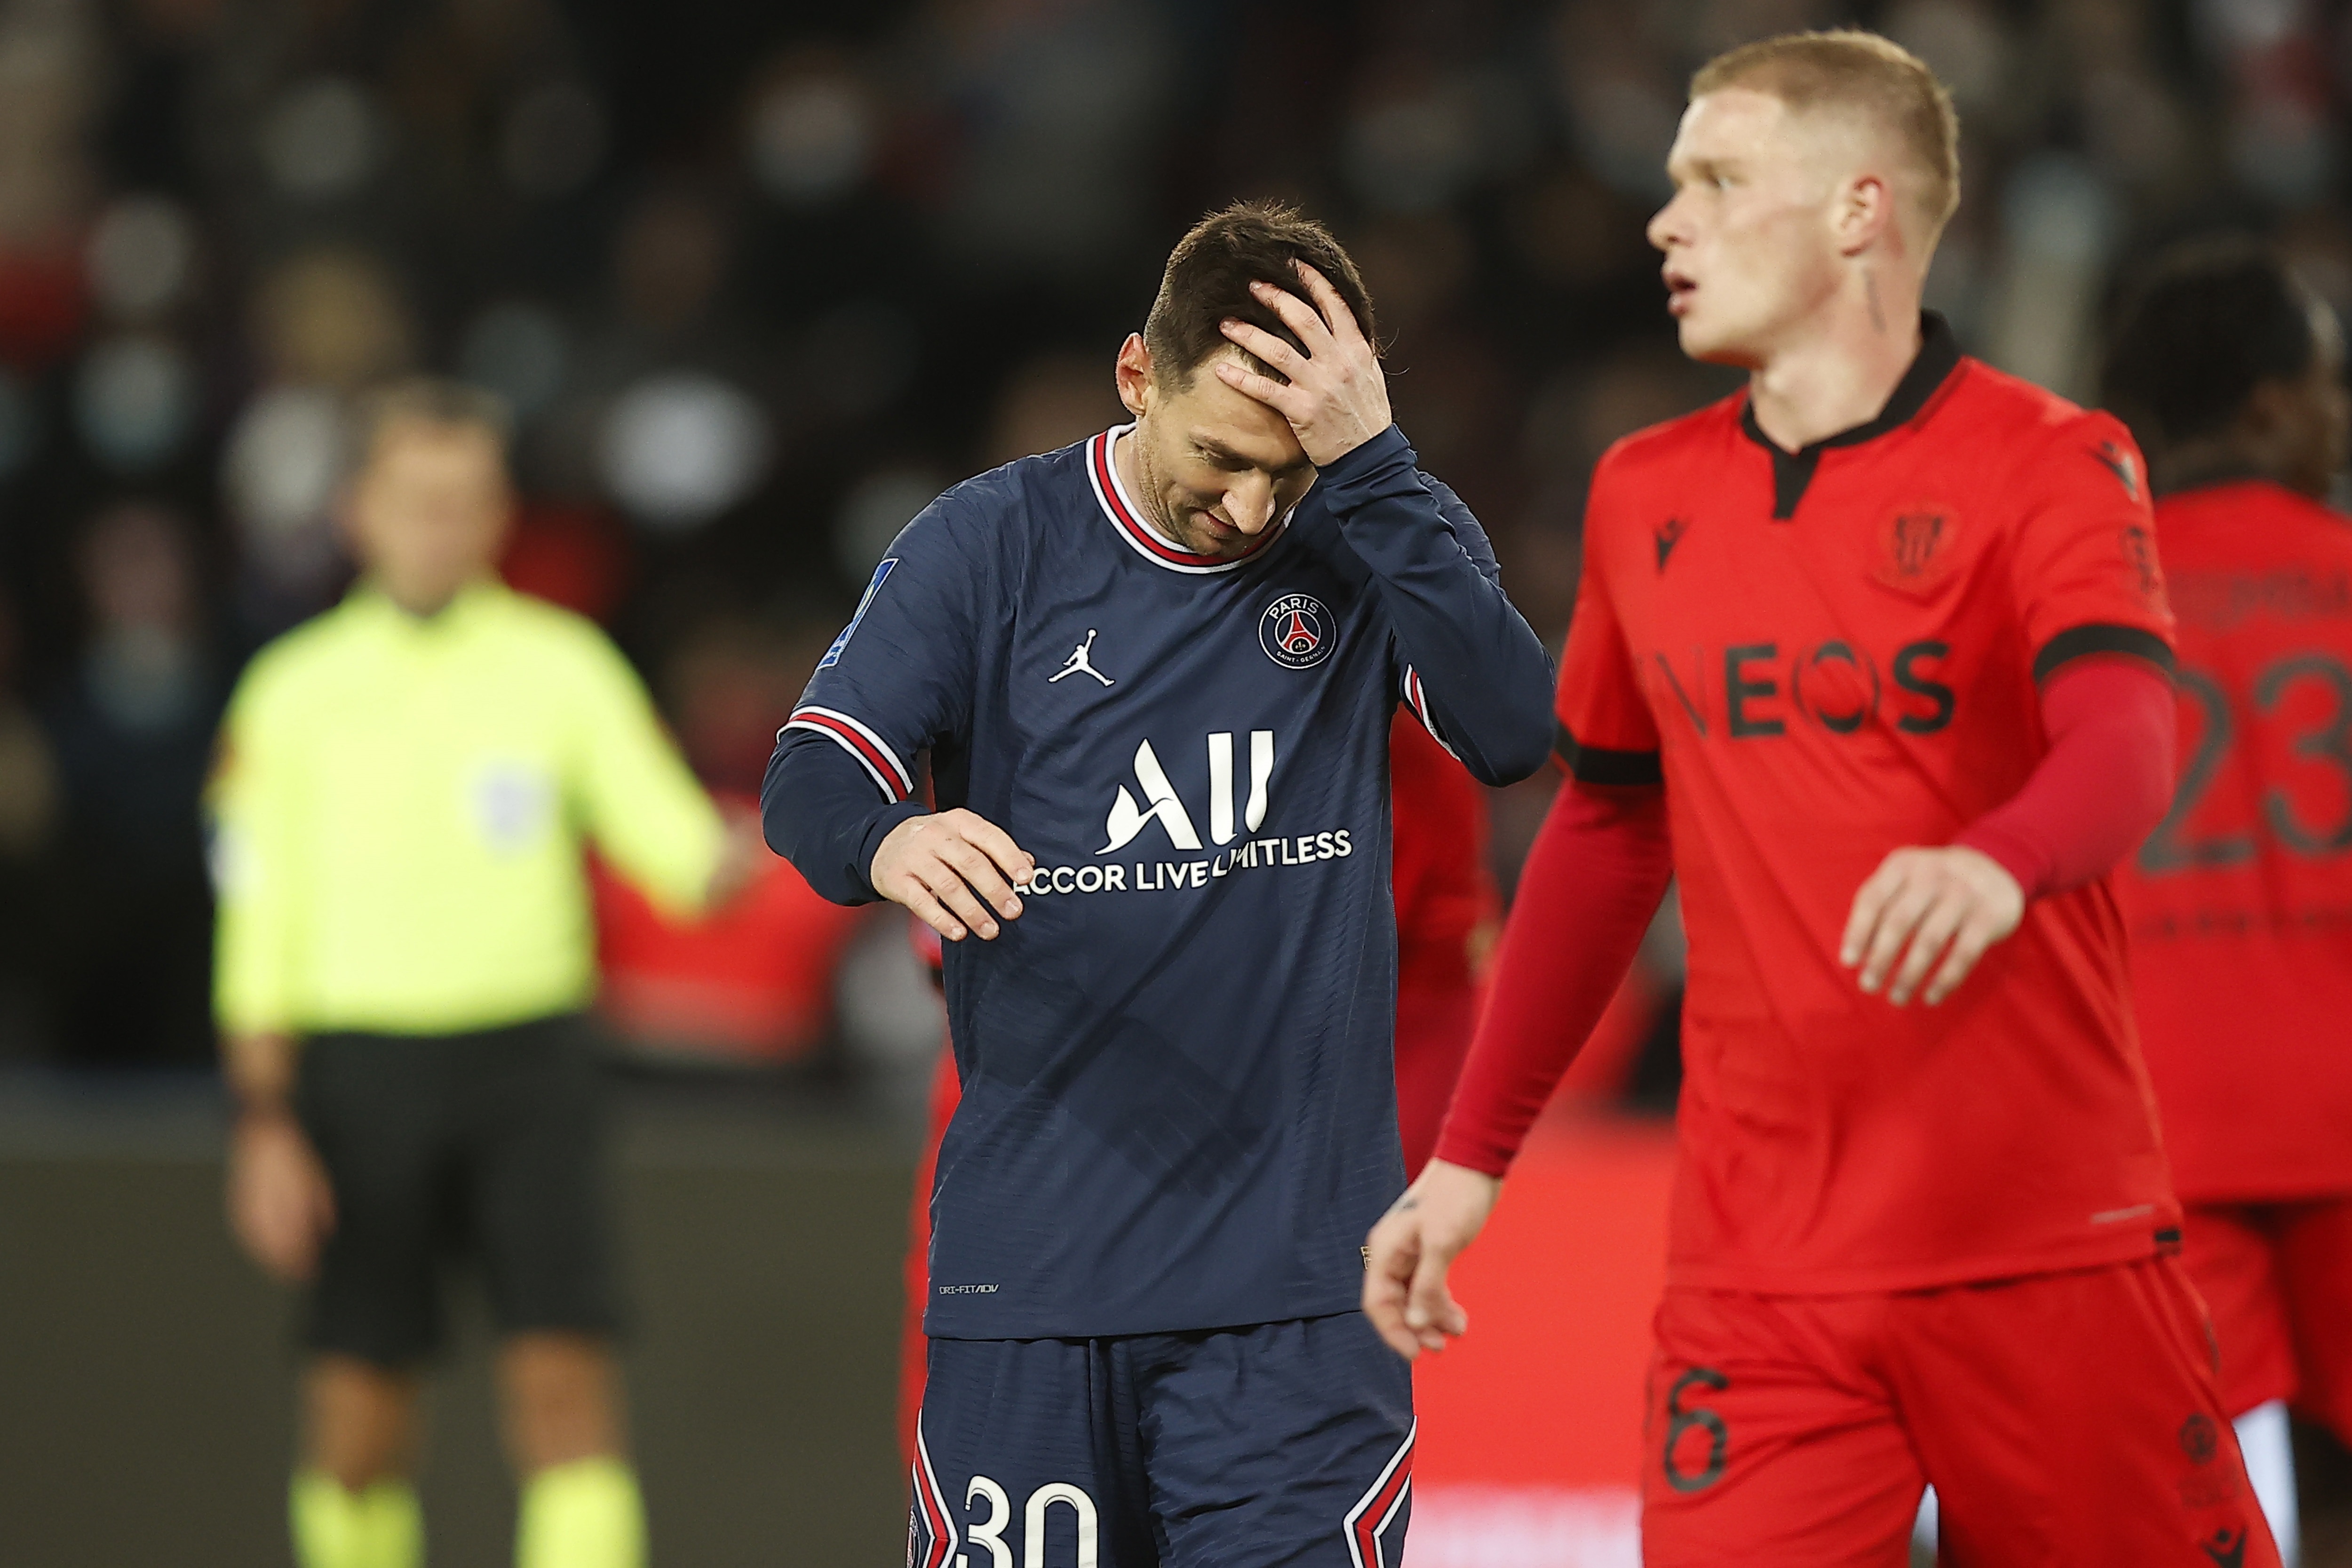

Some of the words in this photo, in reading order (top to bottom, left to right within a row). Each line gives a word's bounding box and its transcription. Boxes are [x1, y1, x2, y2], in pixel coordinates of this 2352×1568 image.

[1269, 597, 1319, 620] PARIS
[2138, 653, 2352, 876] 23
[1136, 861, 1209, 890] LIVE
[1212, 829, 1352, 877] LIMITLESS
[956, 1474, 1098, 1568] 30
